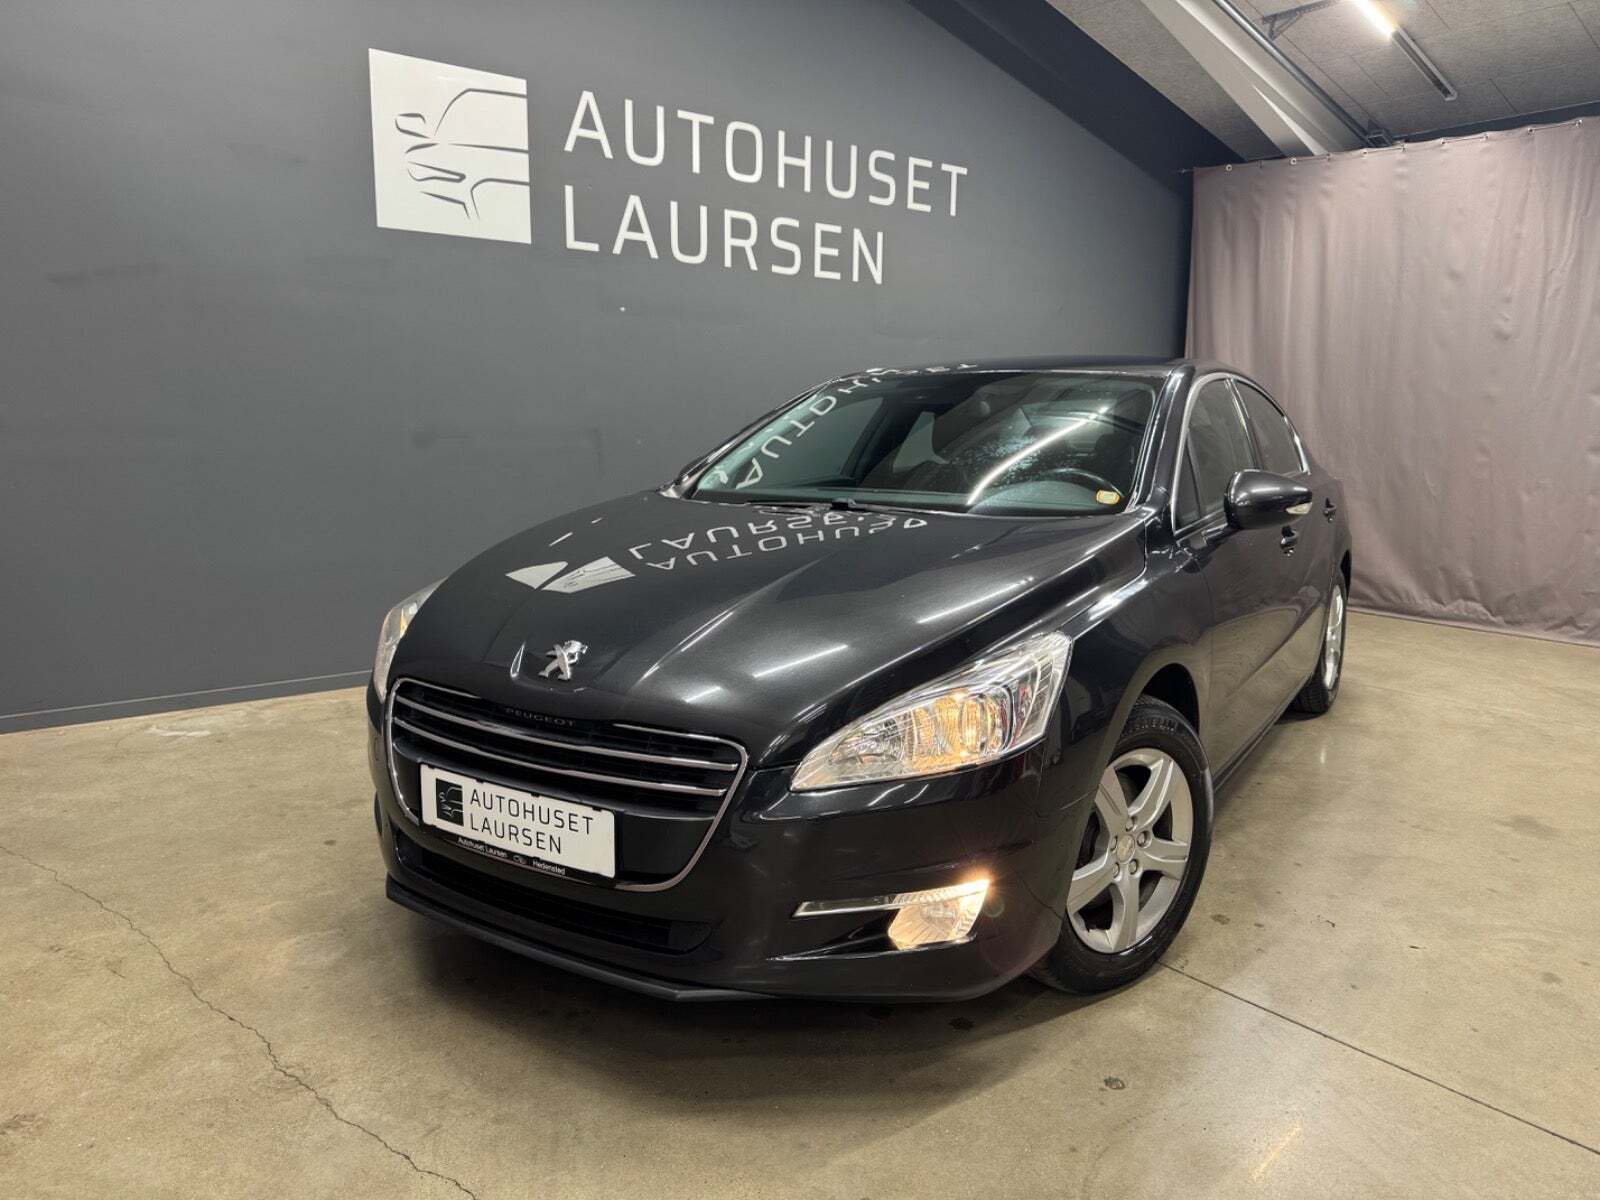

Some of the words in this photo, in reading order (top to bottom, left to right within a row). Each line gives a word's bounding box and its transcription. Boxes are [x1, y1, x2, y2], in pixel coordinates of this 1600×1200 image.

[564, 90, 968, 217] AUTOHUSET
[564, 185, 884, 285] LAURSEN
[505, 706, 577, 727] PEUGEOT
[470, 788, 594, 835] AUTOHUSET
[470, 812, 562, 855] LAURSEN
